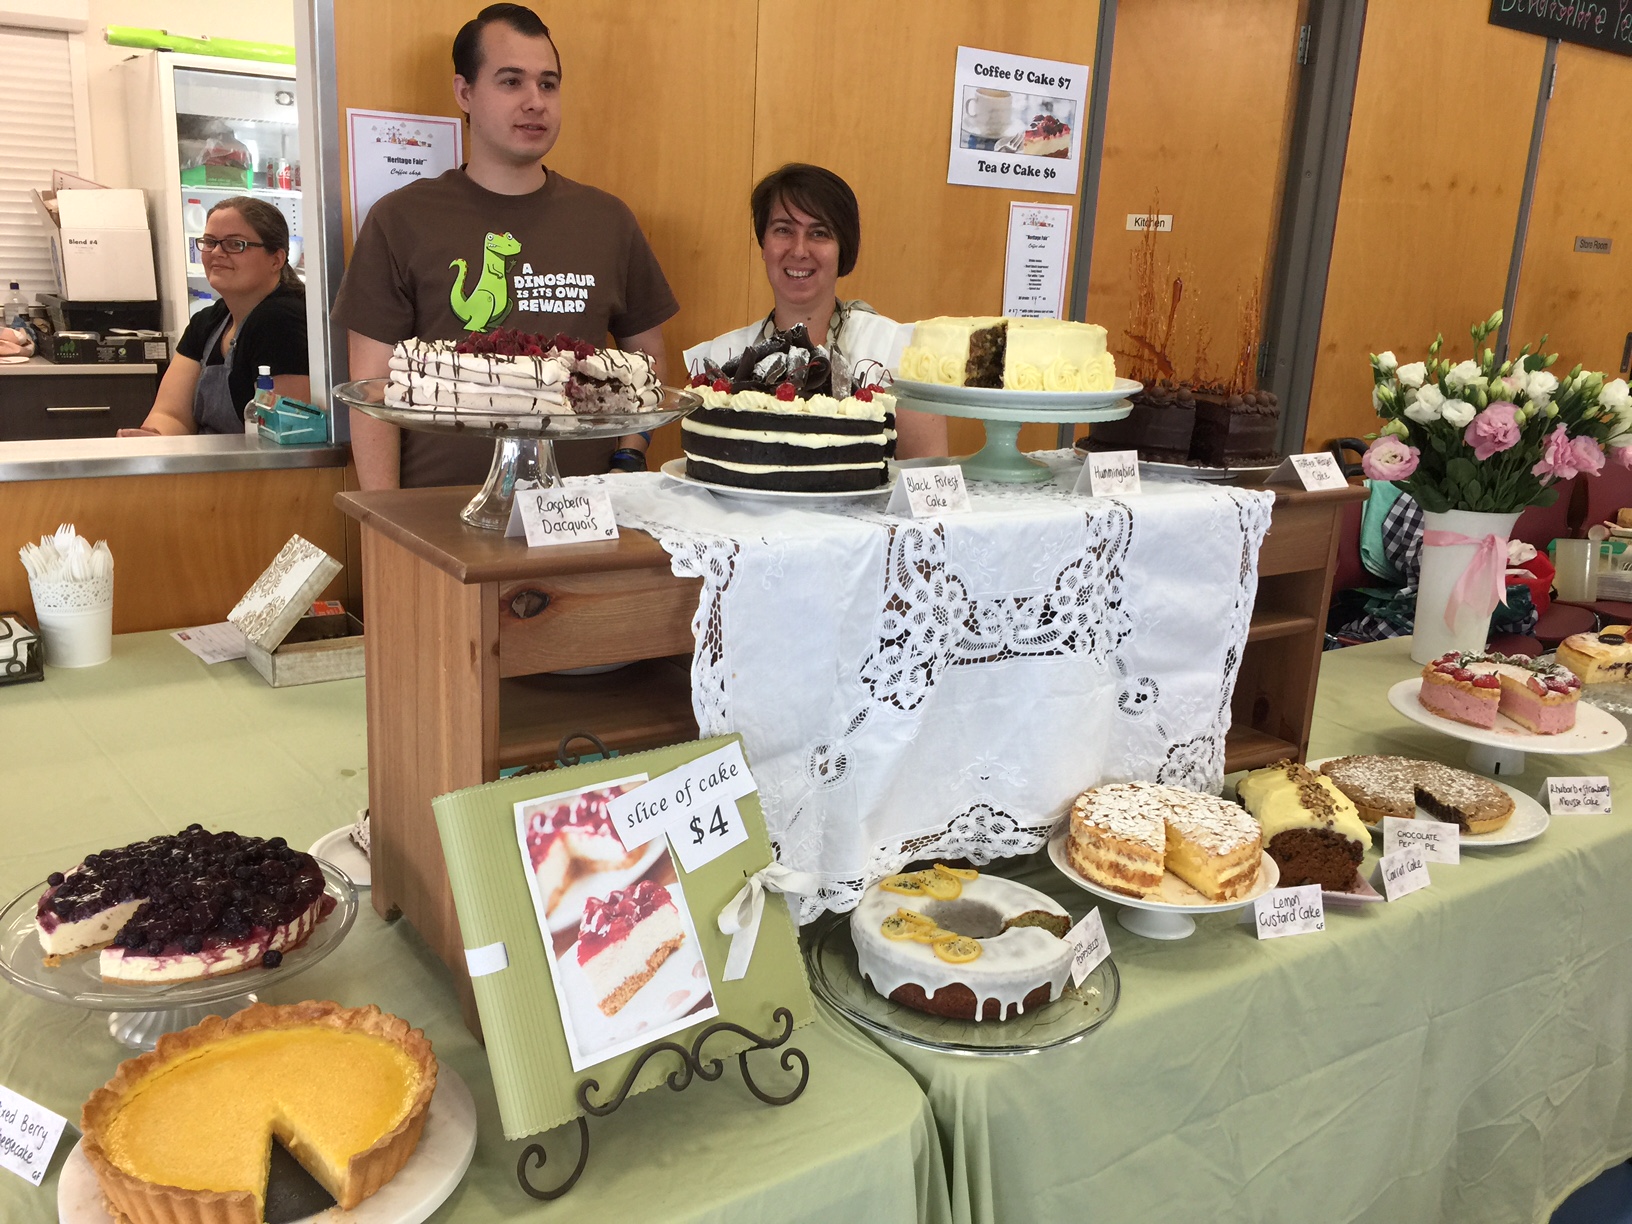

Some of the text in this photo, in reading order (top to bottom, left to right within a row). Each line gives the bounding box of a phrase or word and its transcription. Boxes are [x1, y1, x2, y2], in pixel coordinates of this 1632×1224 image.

[974, 63, 1072, 90] Coffee & Cake $7
[390, 168, 408, 176] Coffee
[977, 160, 1056, 179] Tea & Cake $6
[1134, 217, 1165, 228] Kitchen
[1580, 239, 1608, 250] Store Room
[522, 262, 533, 275] A
[513, 272, 596, 289] DINOSAUR
[516, 286, 588, 300] IS ITS OWN
[518, 298, 586, 314] REWARD
[1094, 463, 1135, 483] Hummingbird
[1311, 470, 1331, 481] Cake
[906, 474, 958, 493] Black Forest
[536, 494, 591, 518] Raspberry
[925, 494, 948, 507] Cake
[542, 517, 598, 536] Dacquois
[605, 528, 614, 536] GF
[627, 761, 739, 828] slice of cake
[1550, 783, 1578, 794] Rhubarb
[1559, 796, 1600, 808] Mousse Cake
[689, 804, 729, 845] $4
[1397, 830, 1440, 842] CHOCOLATE
[1424, 842, 1437, 852] PIE
[1385, 858, 1423, 882] Carrot Cake
[1273, 894, 1300, 909] Lemon
[1259, 904, 1321, 927] Custard Cake
[1075, 938, 1100, 966] POPPYSEED
[20, 1113, 49, 1150] Berry
[0, 1129, 33, 1164] eesecake
[31, 1170, 42, 1181] GF
